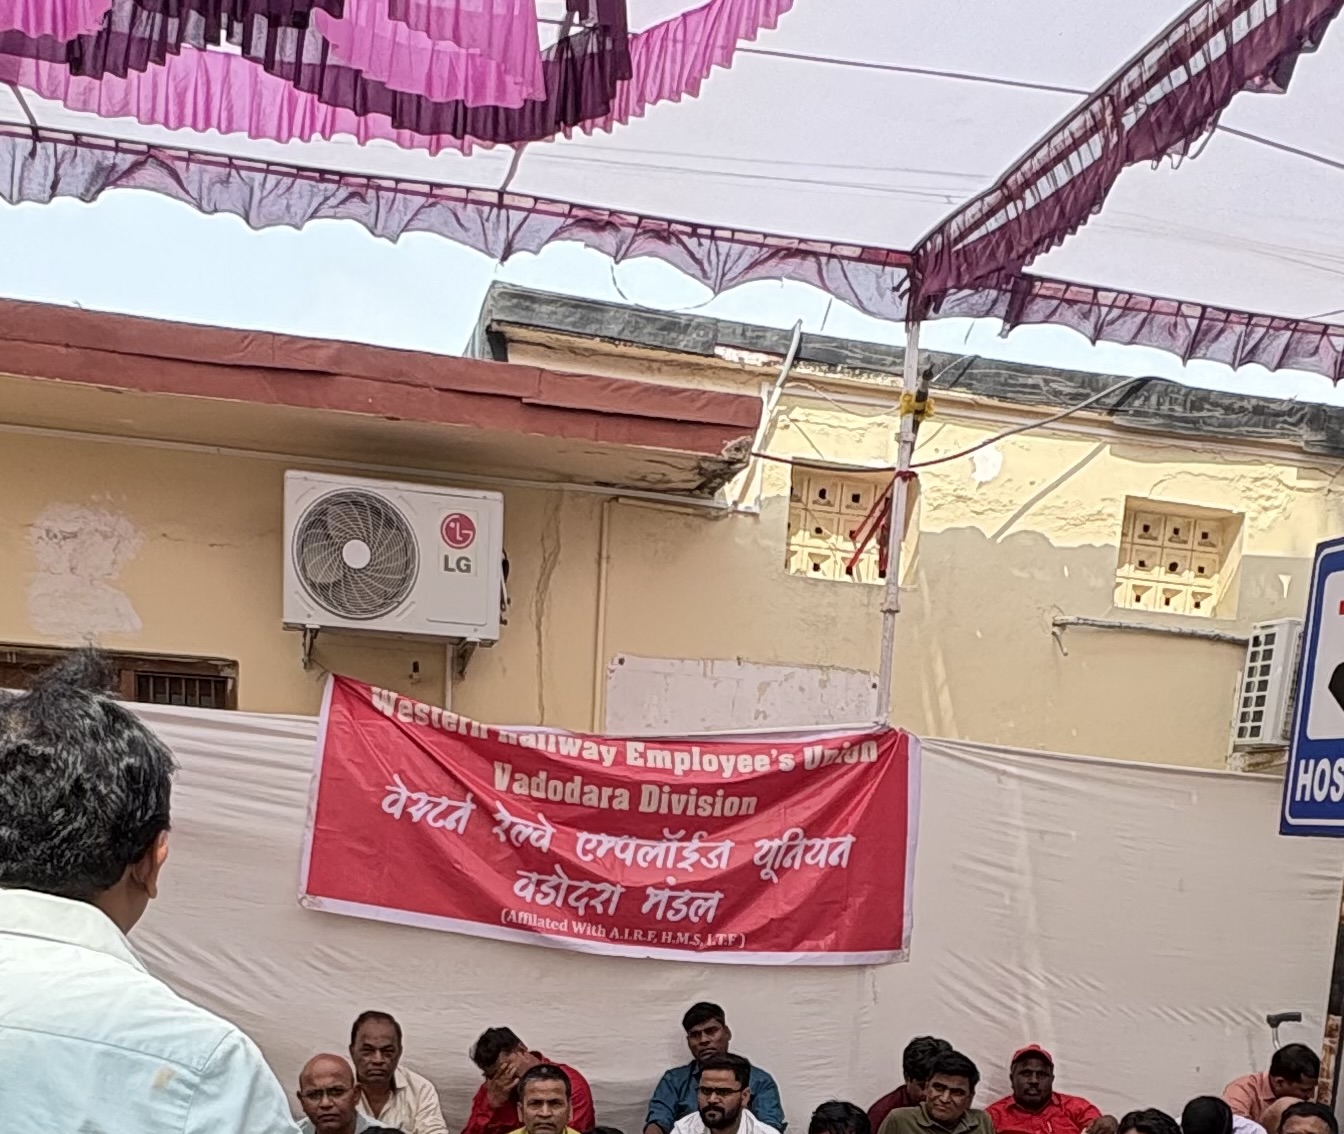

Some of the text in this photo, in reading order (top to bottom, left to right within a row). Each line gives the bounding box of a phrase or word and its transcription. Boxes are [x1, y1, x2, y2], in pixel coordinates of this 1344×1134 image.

[444, 555, 472, 574] LG
[371, 687, 490, 740] Western
[493, 761, 757, 817] Vadodara Division
[753, 827, 856, 881] यूनियन
[513, 864, 724, 924] वडोदरा मंडल
[571, 920, 606, 938] With
